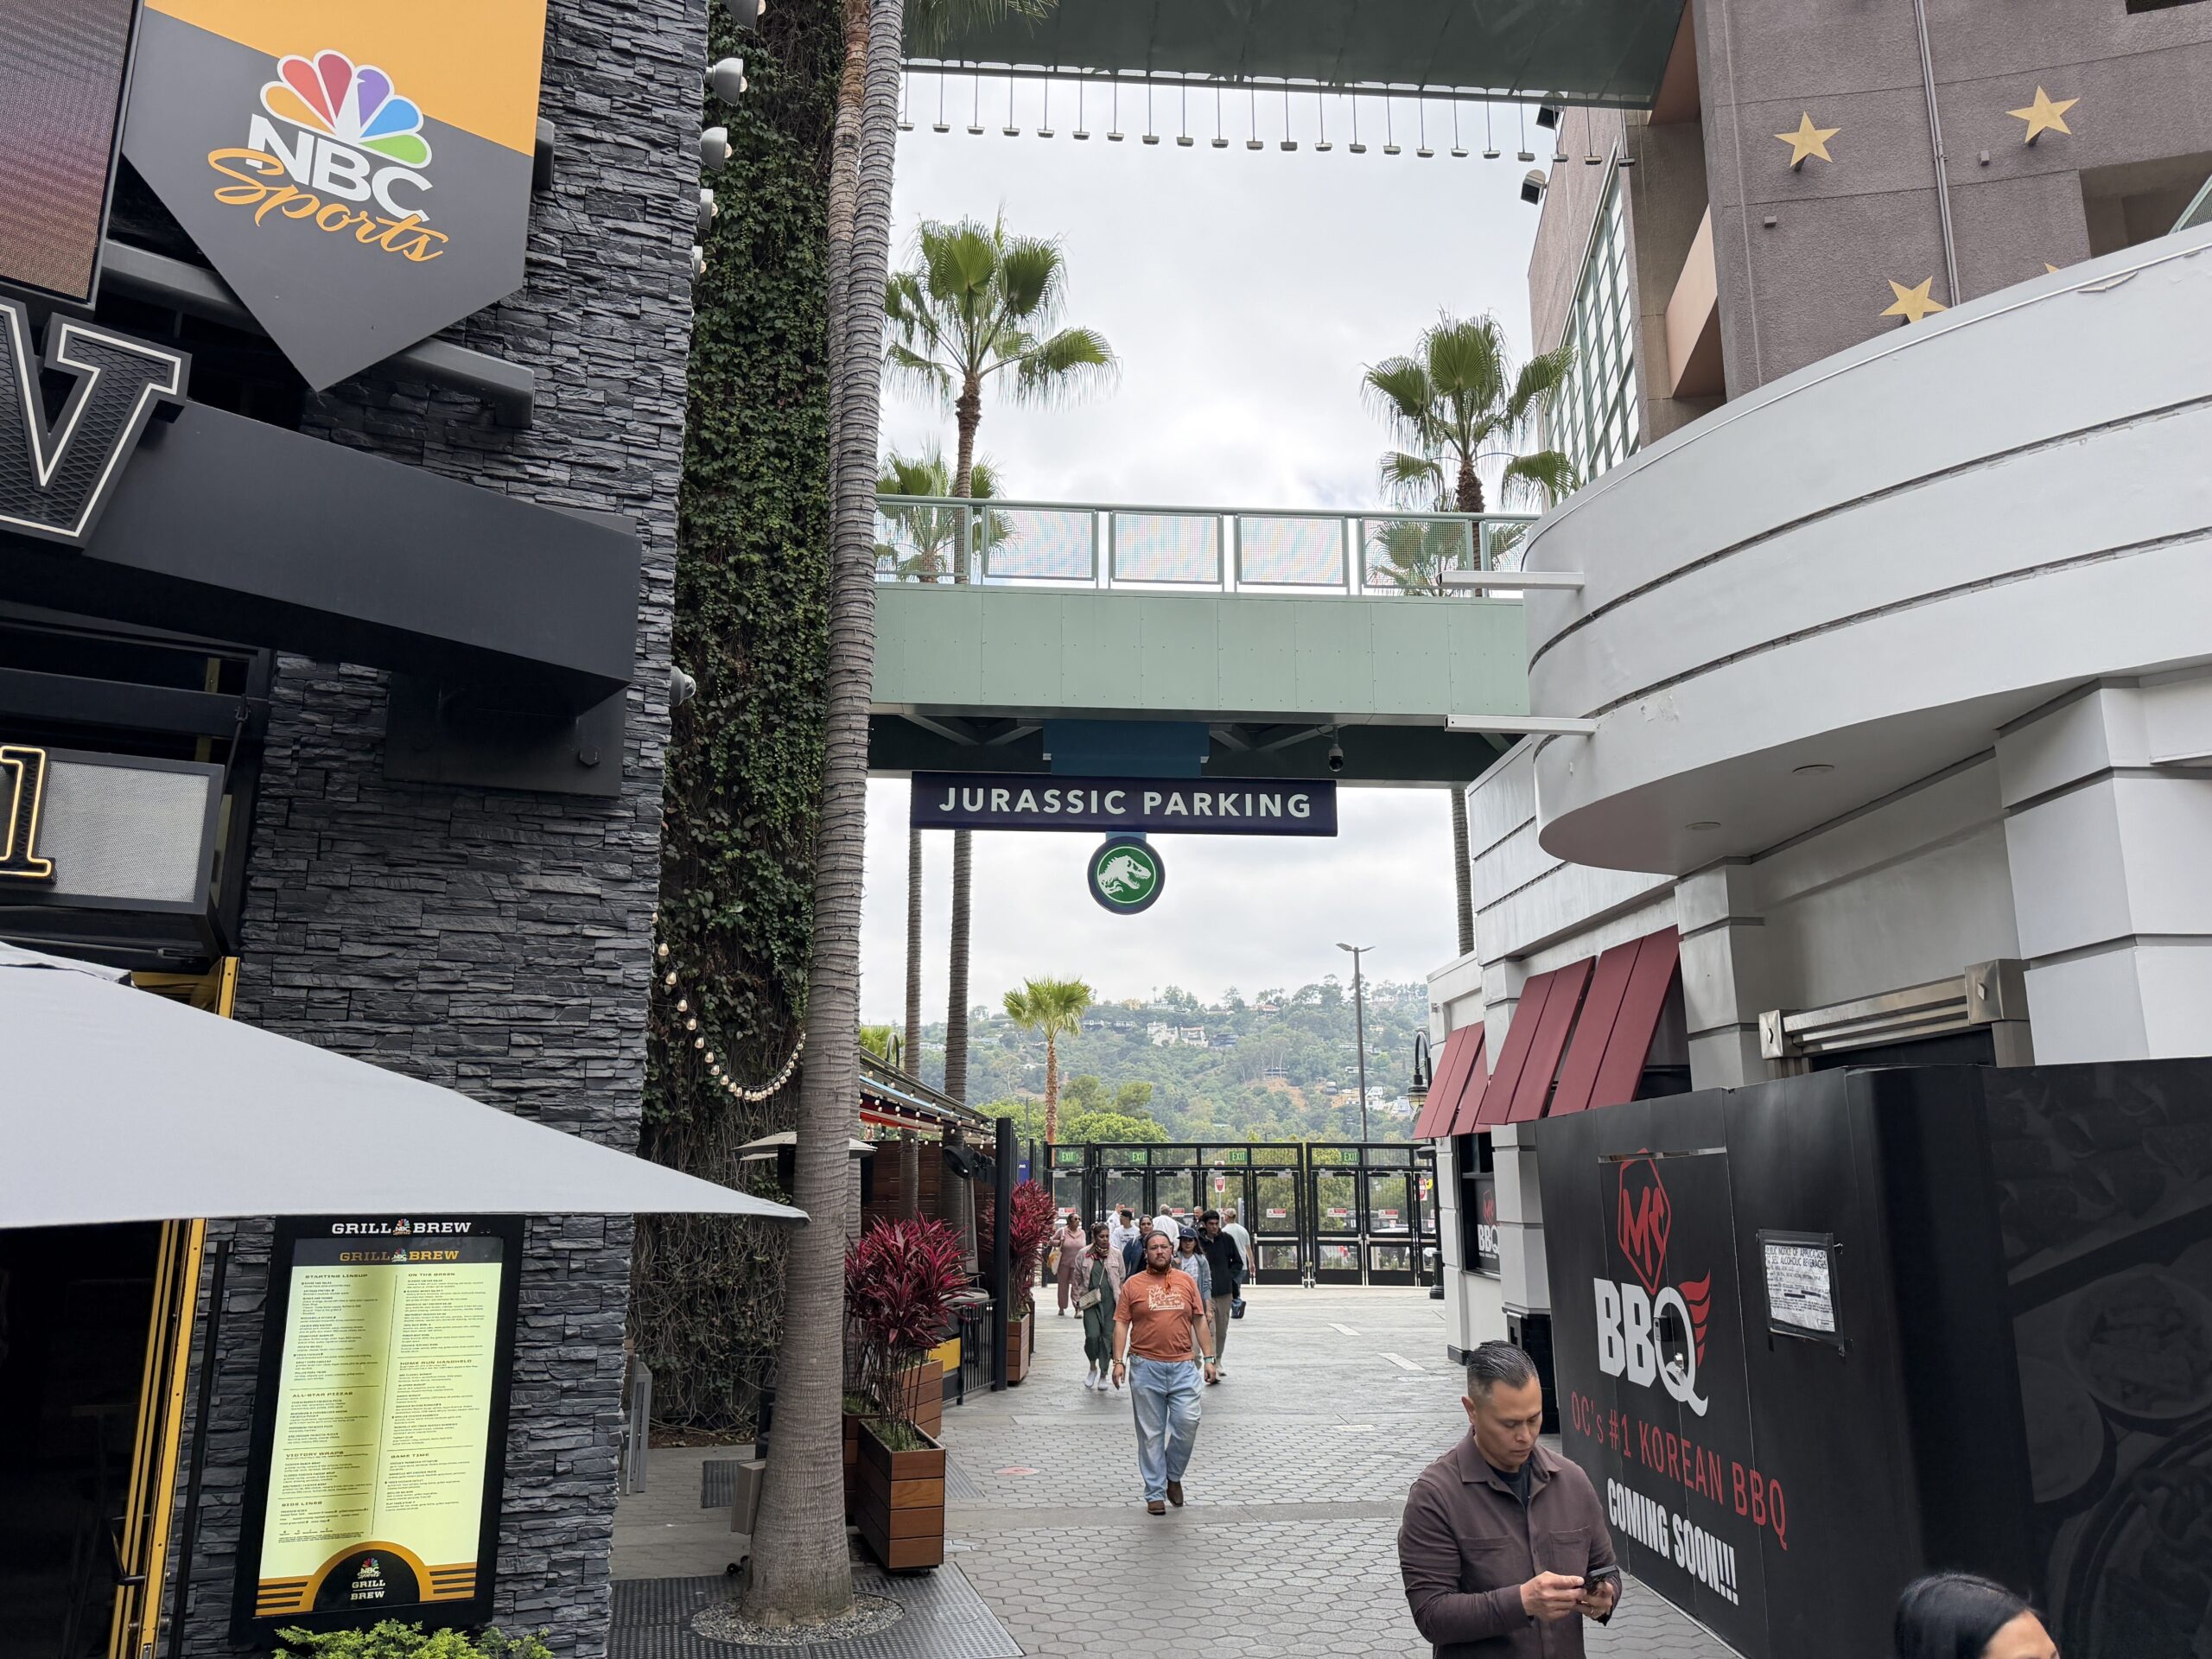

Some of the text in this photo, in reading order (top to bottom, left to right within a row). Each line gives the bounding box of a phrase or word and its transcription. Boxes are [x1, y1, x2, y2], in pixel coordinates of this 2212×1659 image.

[245, 113, 433, 222] NBC
[207, 148, 448, 262] Sports
[938, 787, 1312, 818] JURASSIC PARKING
[1062, 1152, 1073, 1161] EXIT
[1132, 1152, 1146, 1161] EXIT
[1232, 1152, 1245, 1161] EXIT
[1344, 1152, 1357, 1162] EXIT
[332, 1222, 472, 1234] GRILL BREW
[1477, 1224, 1499, 1255] BBQ
[340, 1250, 460, 1262] GRILL BREW
[1593, 1277, 1709, 1417] BBQ
[1571, 1390, 1788, 1551] OC's #1 KOREAN BBQ
[1607, 1478, 1739, 1605] COMING SOON!!!
[360, 1566, 380, 1574] NBC
[352, 1579, 386, 1589] GRILL
[350, 1590, 385, 1600] BREW
